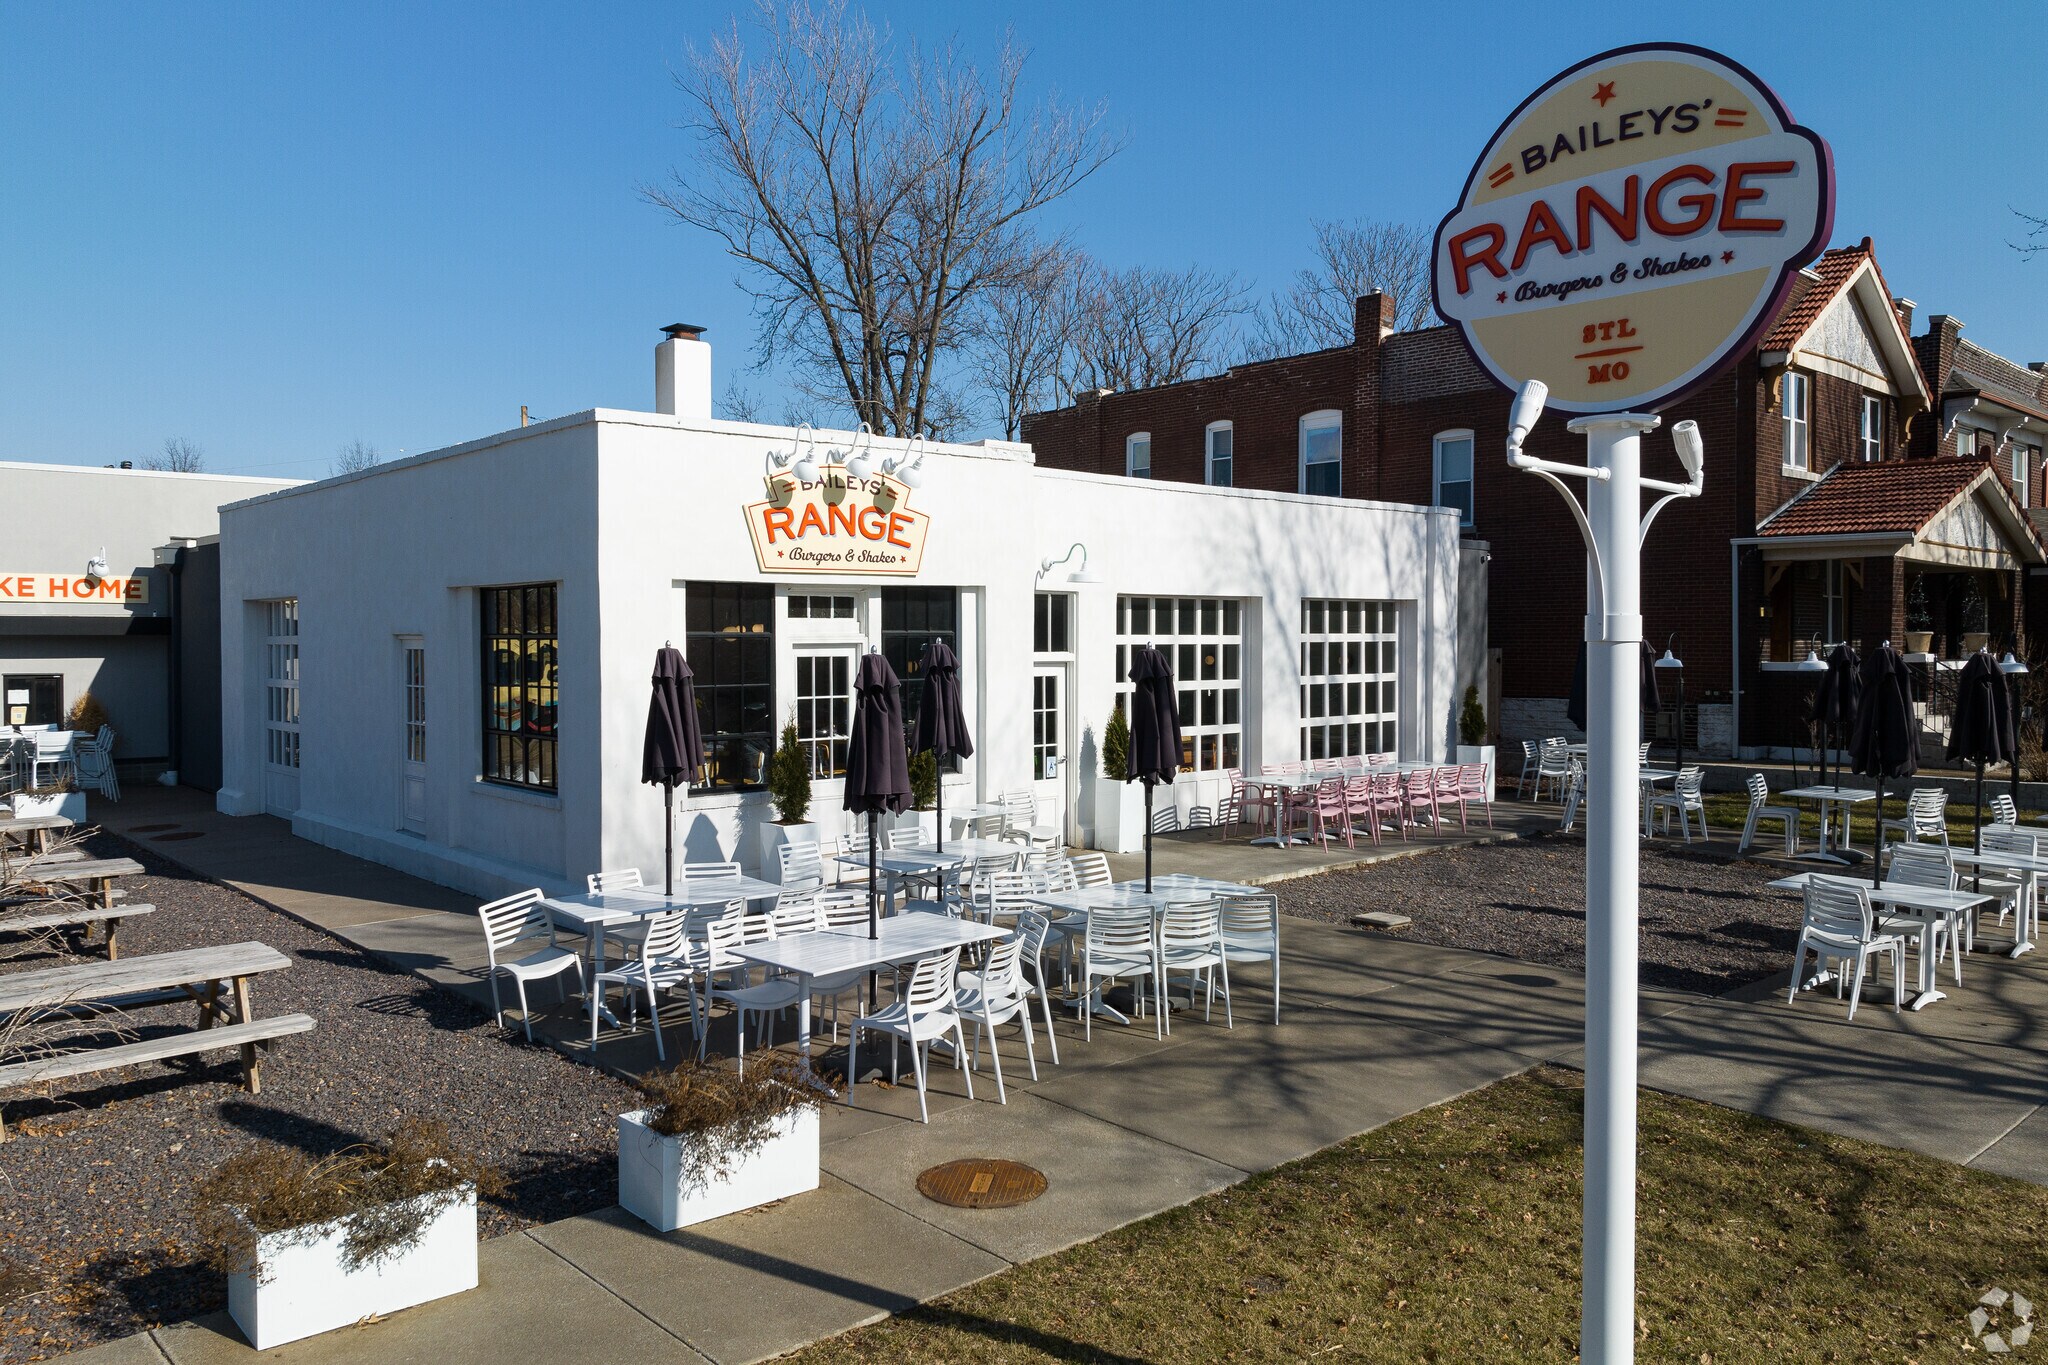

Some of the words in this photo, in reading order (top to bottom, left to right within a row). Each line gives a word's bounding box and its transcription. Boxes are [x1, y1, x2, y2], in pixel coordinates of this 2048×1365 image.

[1520, 99, 1713, 174] BAILEYS'
[1448, 160, 1796, 295] RANGE
[1514, 273, 1603, 302] Burgers
[1609, 262, 1627, 283] &
[1633, 253, 1712, 280] Shakes
[1582, 317, 1637, 343] STL
[1587, 361, 1630, 385] MO
[763, 502, 915, 549] RANGE
[789, 547, 842, 566] Burgers
[845, 549, 855, 563] &
[857, 549, 896, 564] Shakes
[49, 577, 142, 599] HOME
